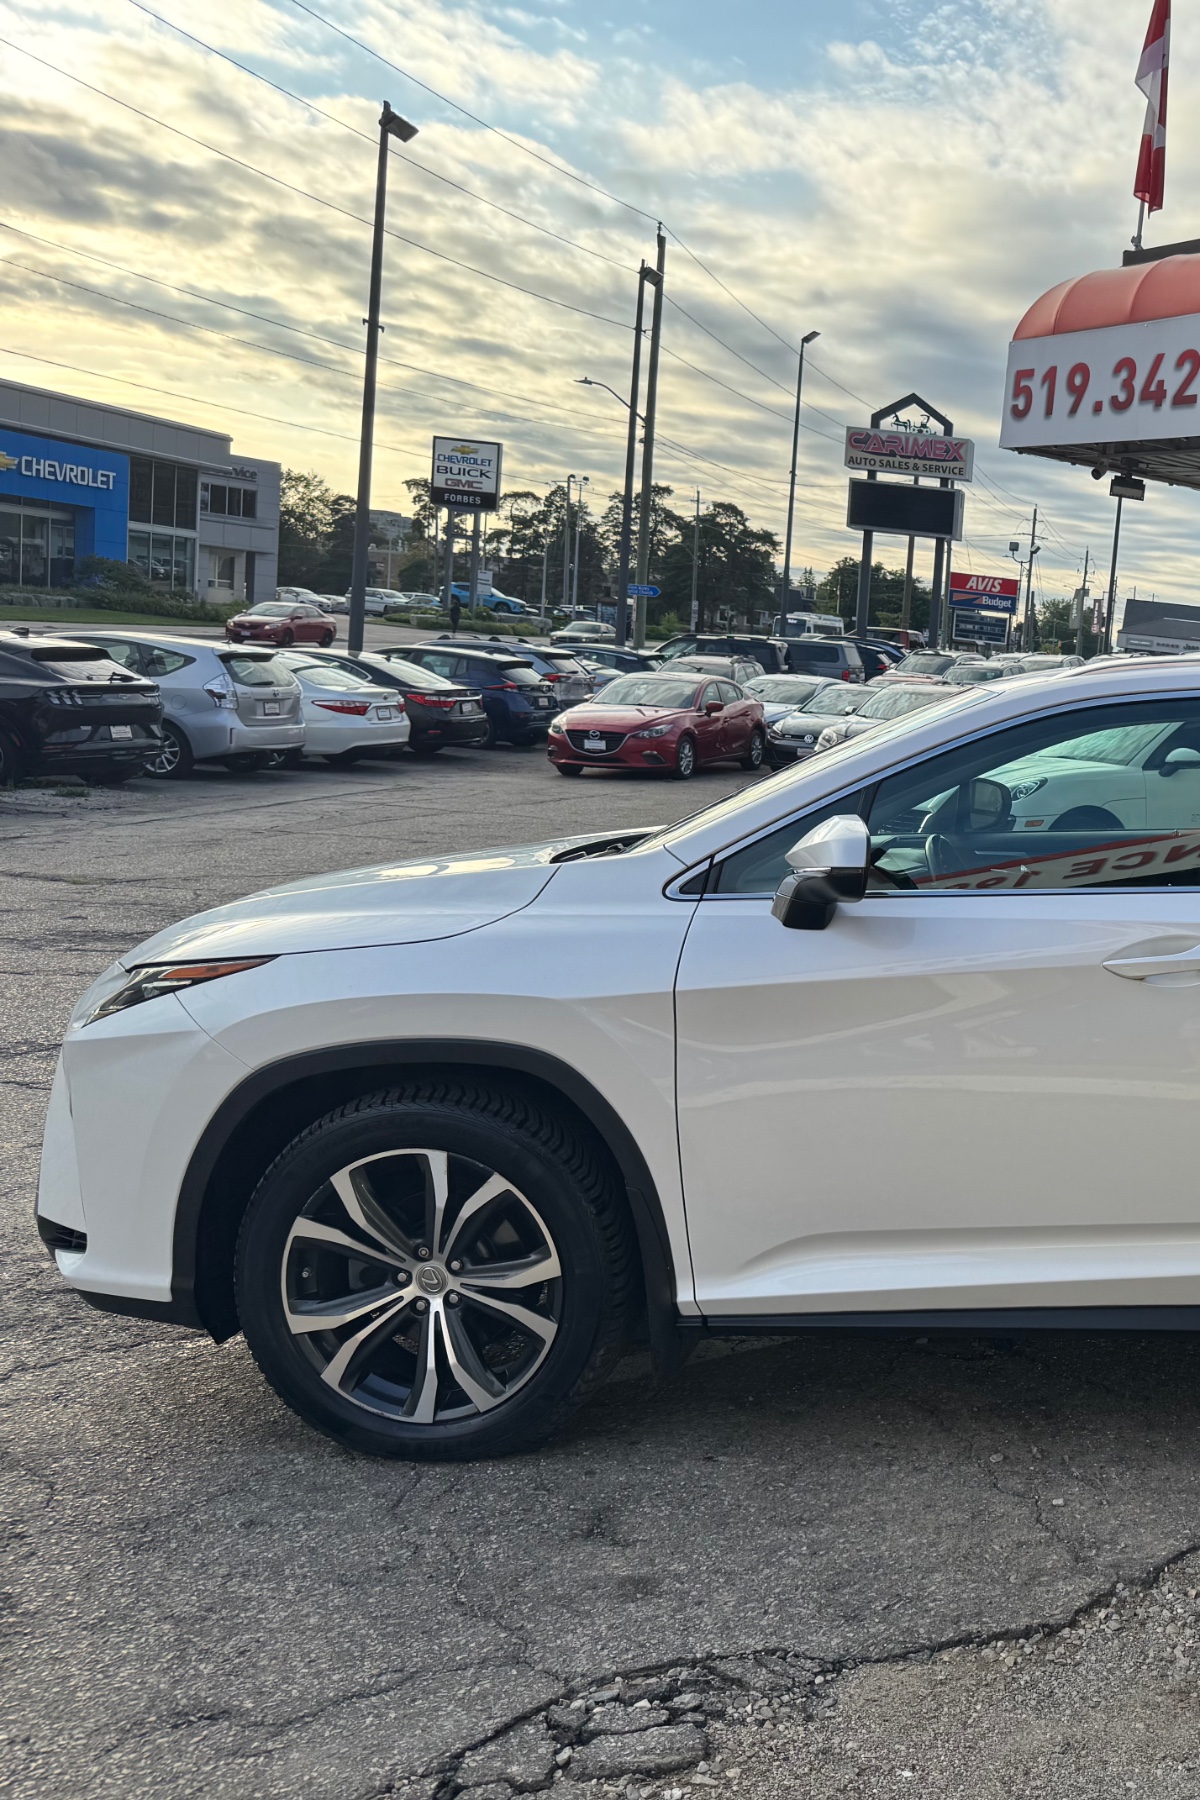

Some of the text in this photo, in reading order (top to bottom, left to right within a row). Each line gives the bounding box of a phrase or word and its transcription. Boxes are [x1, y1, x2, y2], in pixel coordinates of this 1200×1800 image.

[848, 431, 967, 461] CARIMEX
[437, 453, 493, 467] CHEVROLET
[848, 456, 965, 476] AUTO SALES & SERVICE
[21, 455, 117, 490] CHEVROLET
[436, 465, 492, 479] BUICK
[445, 478, 483, 489] GMC
[444, 493, 481, 504] FORBES
[965, 576, 1003, 593] AVIS
[982, 596, 1012, 609] Budget
